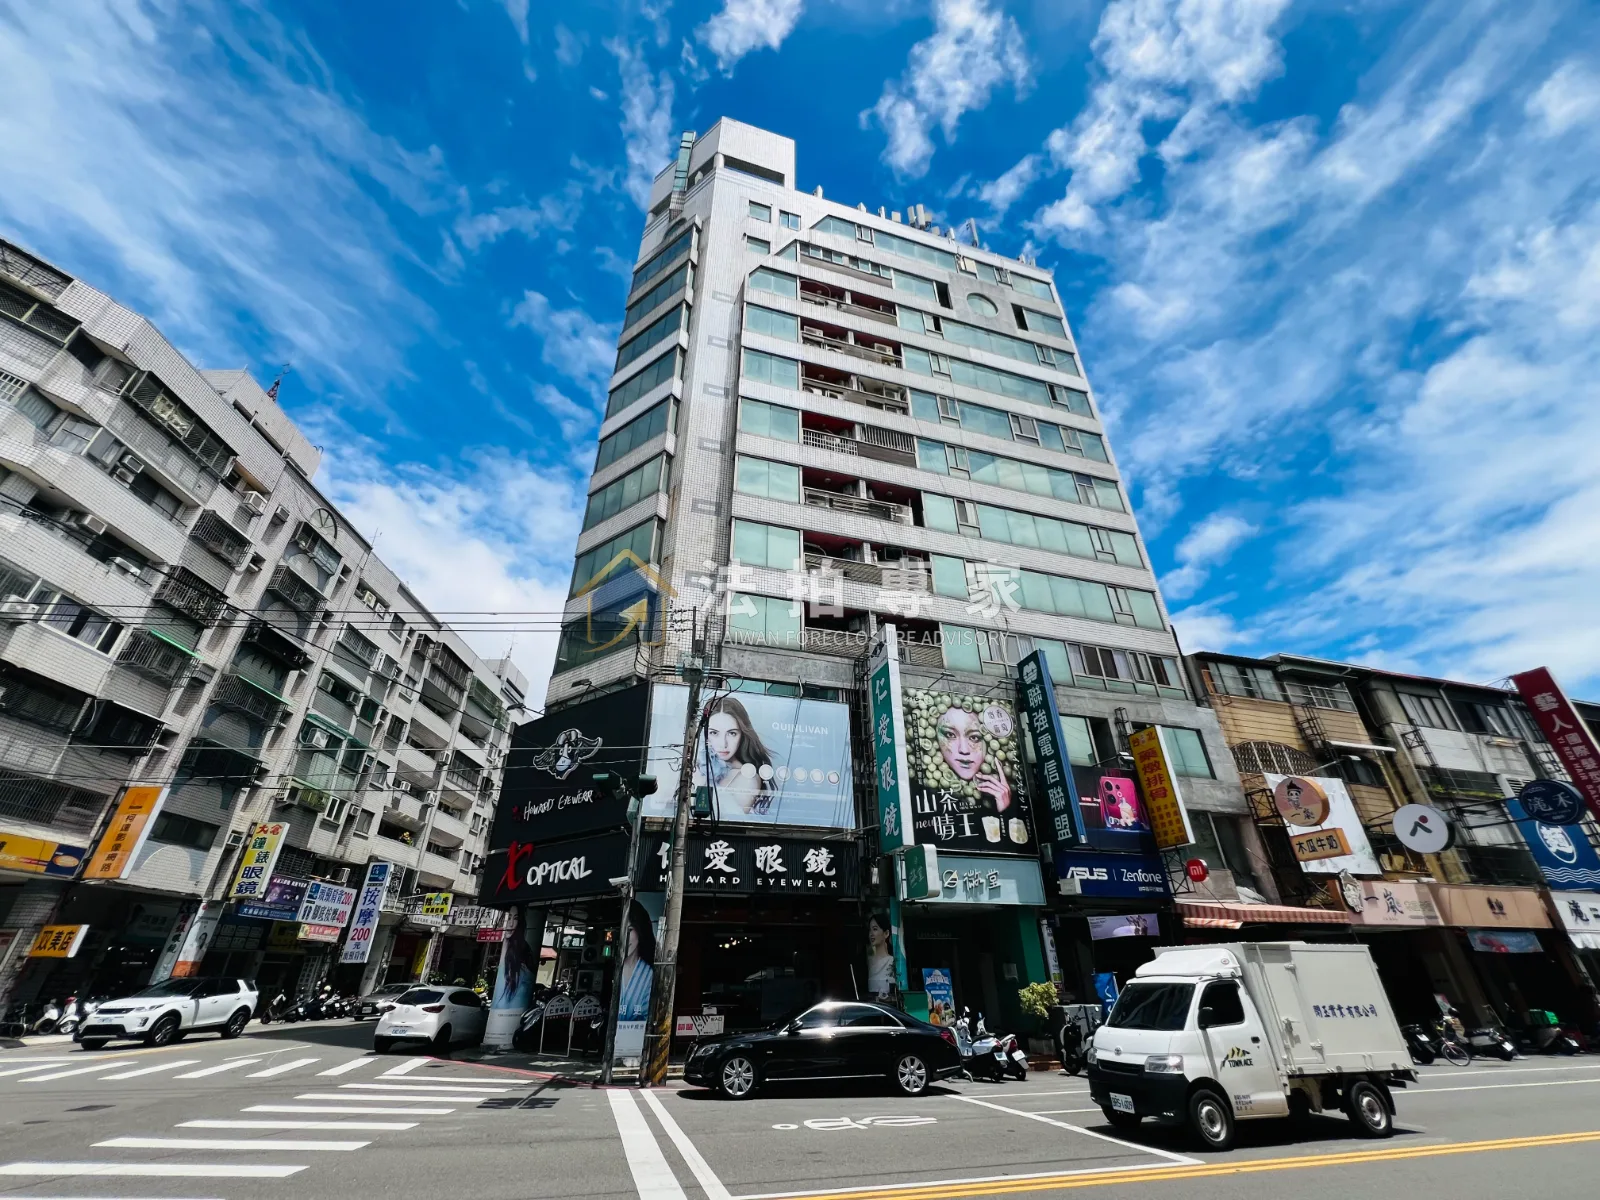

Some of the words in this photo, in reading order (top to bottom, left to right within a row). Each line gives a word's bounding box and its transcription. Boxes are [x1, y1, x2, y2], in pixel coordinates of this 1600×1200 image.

[771, 721, 829, 736] QUINLIVAN
[875, 677, 899, 837] 仁愛眼鏡
[1027, 684, 1073, 841] 聯強電信聯盟
[1585, 784, 1600, 809] SALO
[1295, 834, 1339, 855] 木瓜牛奶
[526, 855, 593, 886] OPTICAL
[1065, 866, 1109, 881] ASUS
[1119, 868, 1163, 883] Zenfone
[659, 874, 741, 885] HWARD
[756, 875, 838, 888] EYEWEAR
[355, 887, 381, 927] 按摩
[350, 928, 371, 942] 200
[352, 942, 362, 950] 元
[1227, 1059, 1243, 1068] TOWN
[1243, 1058, 1254, 1067] ACE
